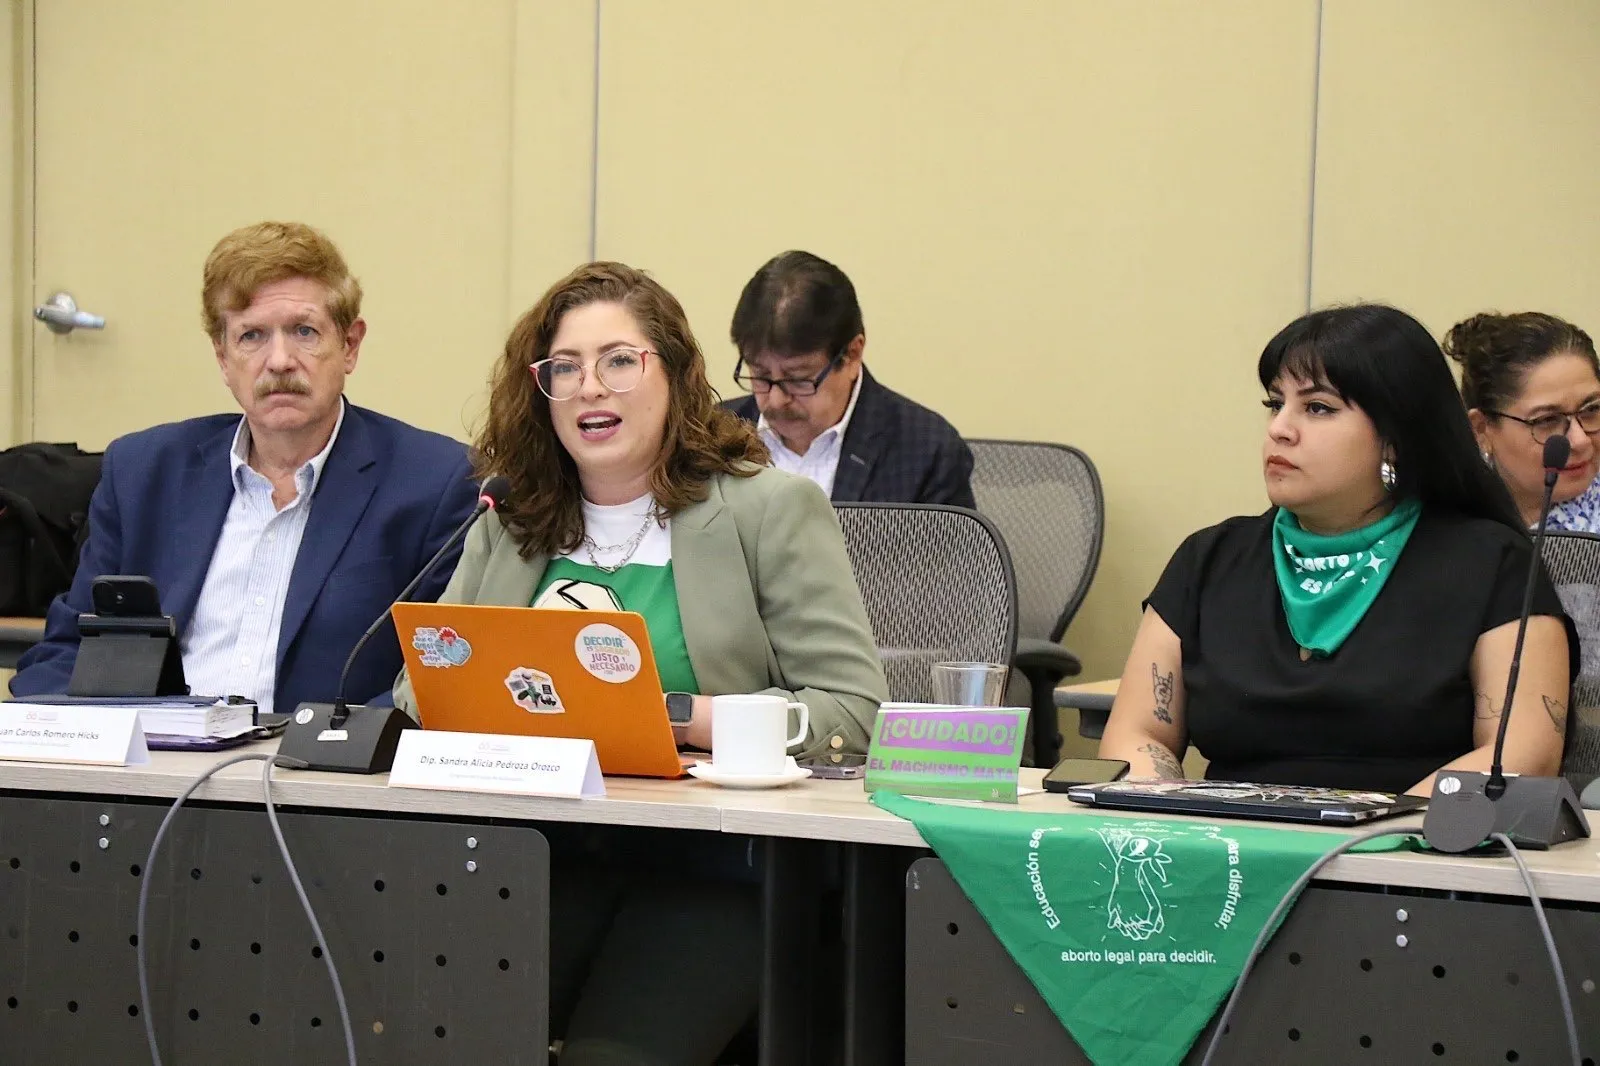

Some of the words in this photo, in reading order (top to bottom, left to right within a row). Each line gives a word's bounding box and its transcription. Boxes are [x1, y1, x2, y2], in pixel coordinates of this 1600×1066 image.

[583, 636, 624, 648] DECIDIR
[591, 652, 620, 664] JUSTO
[589, 662, 636, 673] NECESARIO
[16, 728, 41, 737] Carlos
[43, 729, 76, 739] Romero
[77, 731, 100, 740] Hicks
[881, 717, 1018, 747] ¡CUIDADO!
[420, 755, 437, 765] Dip.
[439, 756, 468, 767] Sandra
[470, 758, 494, 768] Alicia
[495, 760, 529, 771] Pedroza
[531, 761, 561, 773] Orozco
[869, 758, 886, 771] EL
[890, 759, 969, 776] MACHISMO
[973, 766, 1014, 779] MATA
[1025, 851, 1061, 930] Educación
[1214, 868, 1244, 931] disfrutar,
[1061, 949, 1101, 962] aborto
[1104, 949, 1136, 965] legal
[1138, 952, 1167, 964] para
[1169, 950, 1217, 963] decidir.
